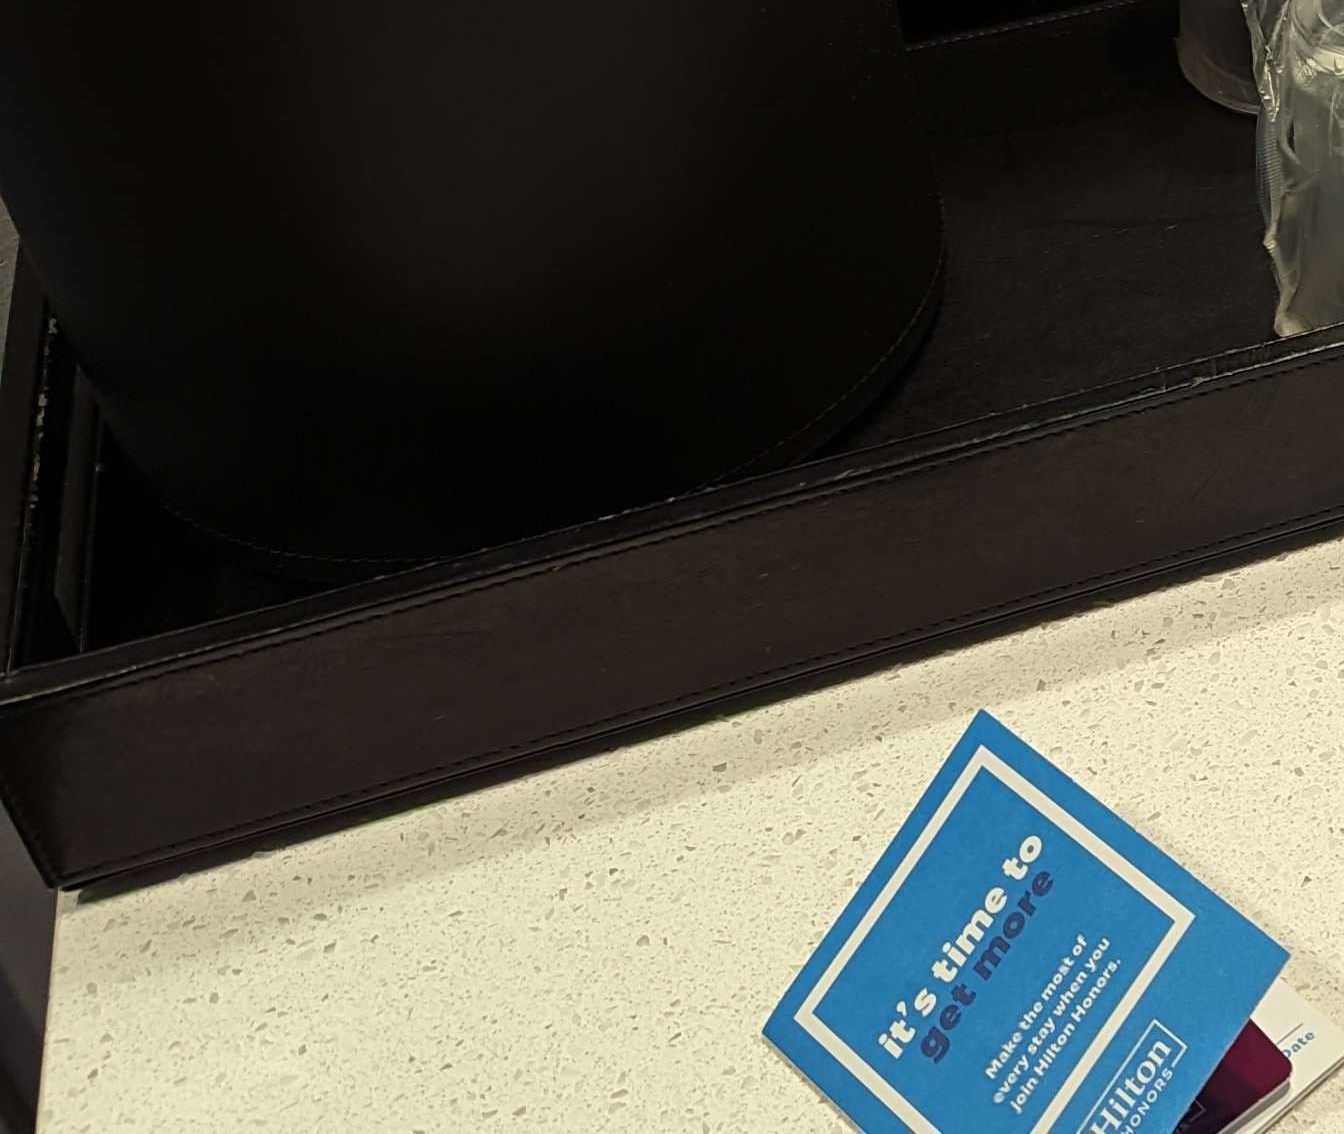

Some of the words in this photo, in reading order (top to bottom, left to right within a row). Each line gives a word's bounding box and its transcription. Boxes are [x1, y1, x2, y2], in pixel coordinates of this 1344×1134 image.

[920, 982, 977, 1064] get
[972, 871, 1054, 981] more
[931, 887, 1008, 983] time
[1001, 835, 1043, 881] to
[984, 1031, 1024, 1080] Make
[1018, 1001, 1044, 1031] the
[1041, 955, 1075, 1002] most
[1072, 934, 1088, 957] of
[993, 1054, 1032, 1104] every
[1027, 1016, 1057, 1057] stay
[1052, 969, 1088, 1018] when
[1084, 937, 1111, 973] you
[1009, 1074, 1039, 1115] join
[1033, 1022, 1076, 1078] Hilton
[1070, 958, 1122, 1023] Honors.
[1090, 1040, 1172, 1134] Hilton
[1120, 1067, 1173, 1134] HONORS
